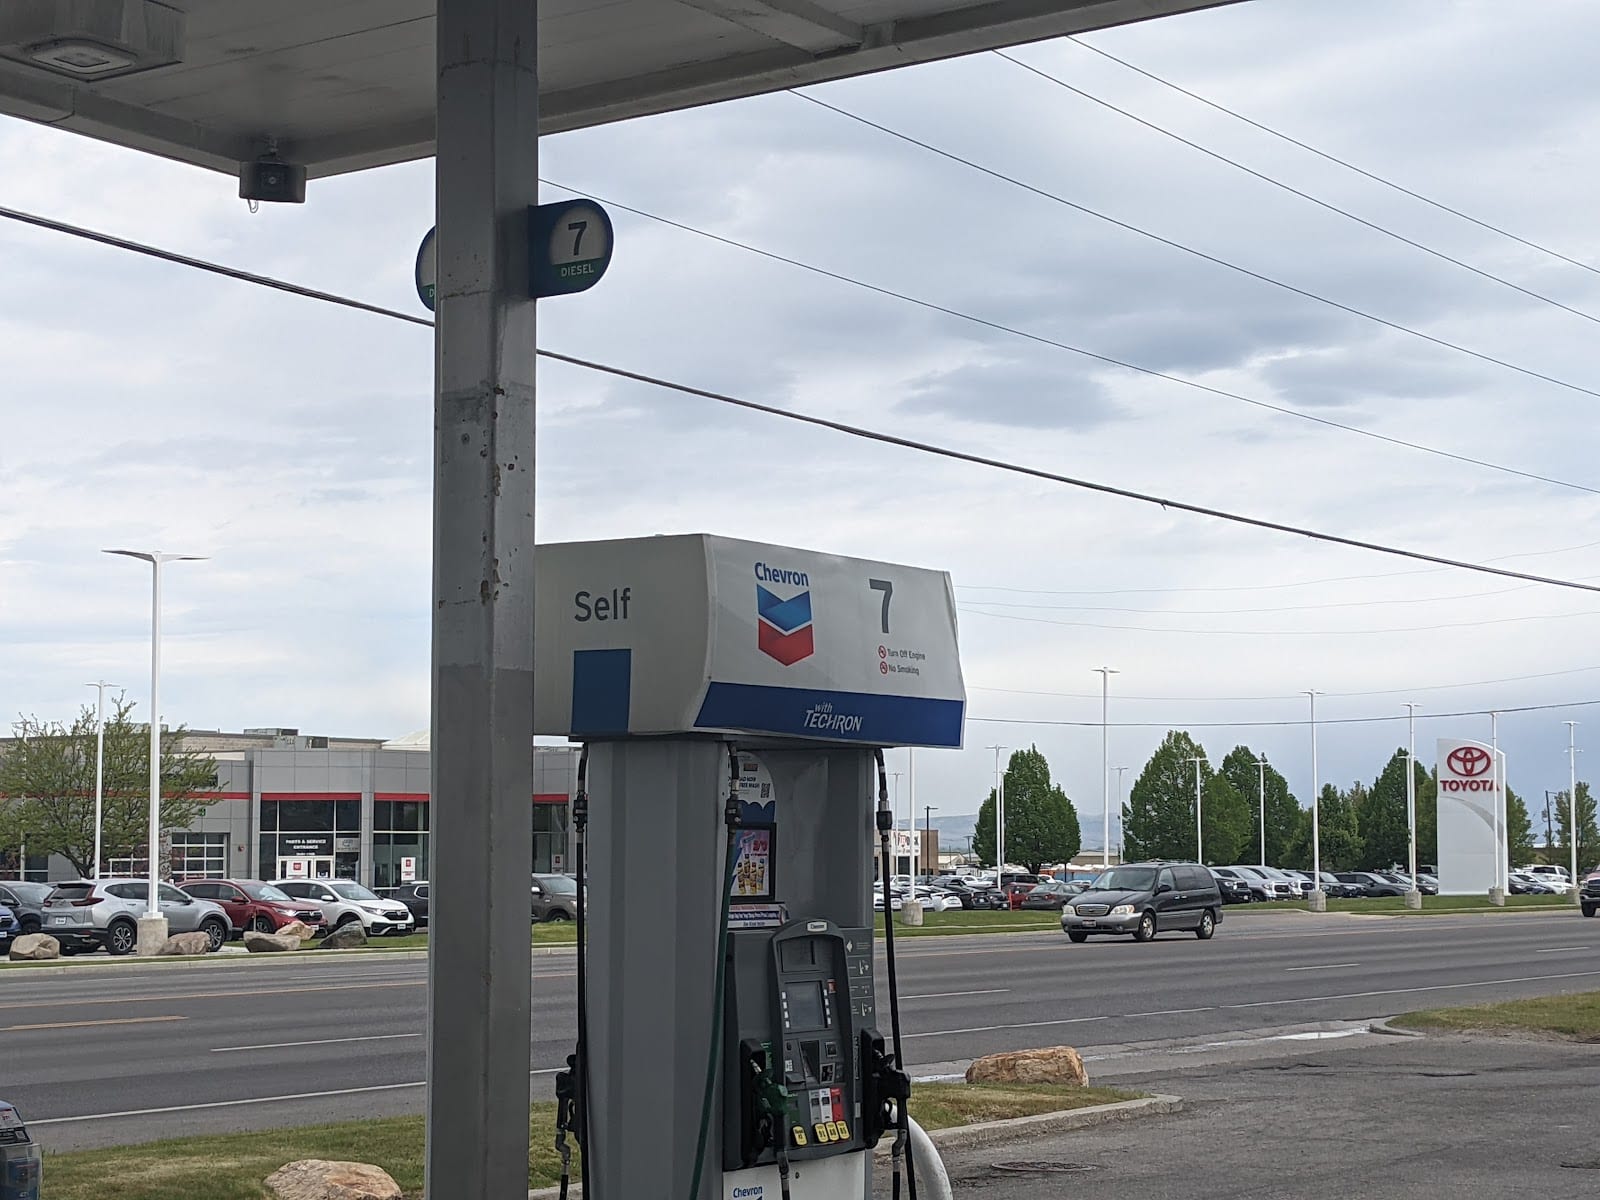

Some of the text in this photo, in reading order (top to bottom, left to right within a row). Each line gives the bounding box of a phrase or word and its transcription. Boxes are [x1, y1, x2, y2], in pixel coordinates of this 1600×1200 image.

[568, 221, 588, 256] 7
[561, 263, 595, 278] DIESEL
[754, 562, 809, 587] Chevron
[574, 587, 631, 622] Self
[869, 578, 893, 634] 7
[908, 650, 926, 661] Engine
[888, 664, 920, 677] No Smoking
[814, 701, 833, 713] with
[803, 709, 863, 735] TECHRON
[1439, 779, 1501, 792] TOYOTA
[732, 1186, 763, 1198] Chevron
